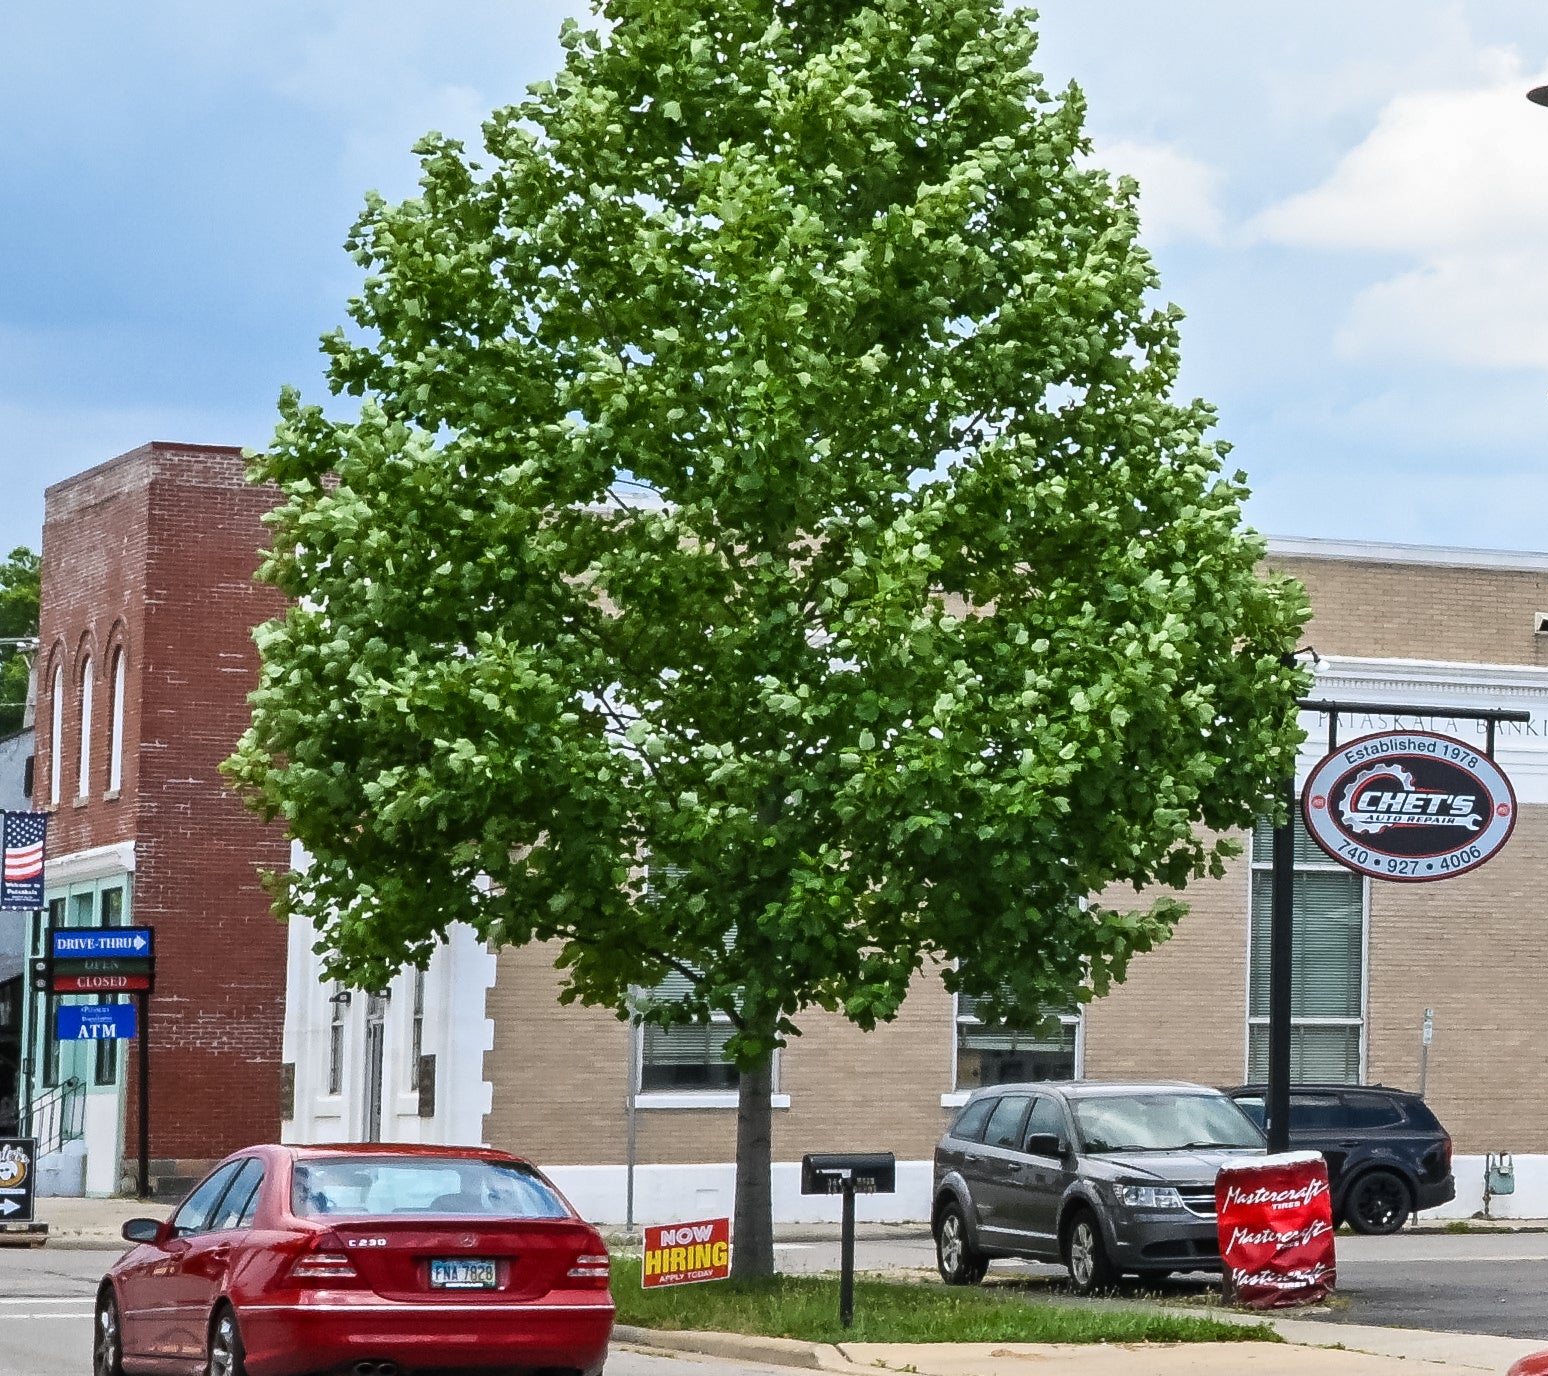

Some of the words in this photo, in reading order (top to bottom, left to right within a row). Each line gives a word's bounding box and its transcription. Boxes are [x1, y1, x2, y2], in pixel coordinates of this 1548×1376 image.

[1344, 738, 1437, 765] Established
[1442, 744, 1479, 769] 1978
[1357, 791, 1476, 815] CHET'S
[1366, 813, 1405, 822] AUTO
[1406, 815, 1457, 824] REPAIR
[1336, 838, 1369, 865] 740
[1387, 860, 1420, 874] 927
[1440, 845, 1482, 871] 4006
[57, 936, 132, 950] DRIVE-THRU
[76, 975, 128, 988] CLOSED
[77, 1024, 117, 1039] ATM
[1222, 1178, 1330, 1214] Mastercraft
[1272, 1201, 1301, 1210] TIRES
[660, 1224, 714, 1247] NOW
[645, 1241, 728, 1275] HIRING
[435, 1265, 459, 1280] FNA
[659, 1273, 684, 1283] APPLY
[687, 1269, 714, 1279] TODAY
